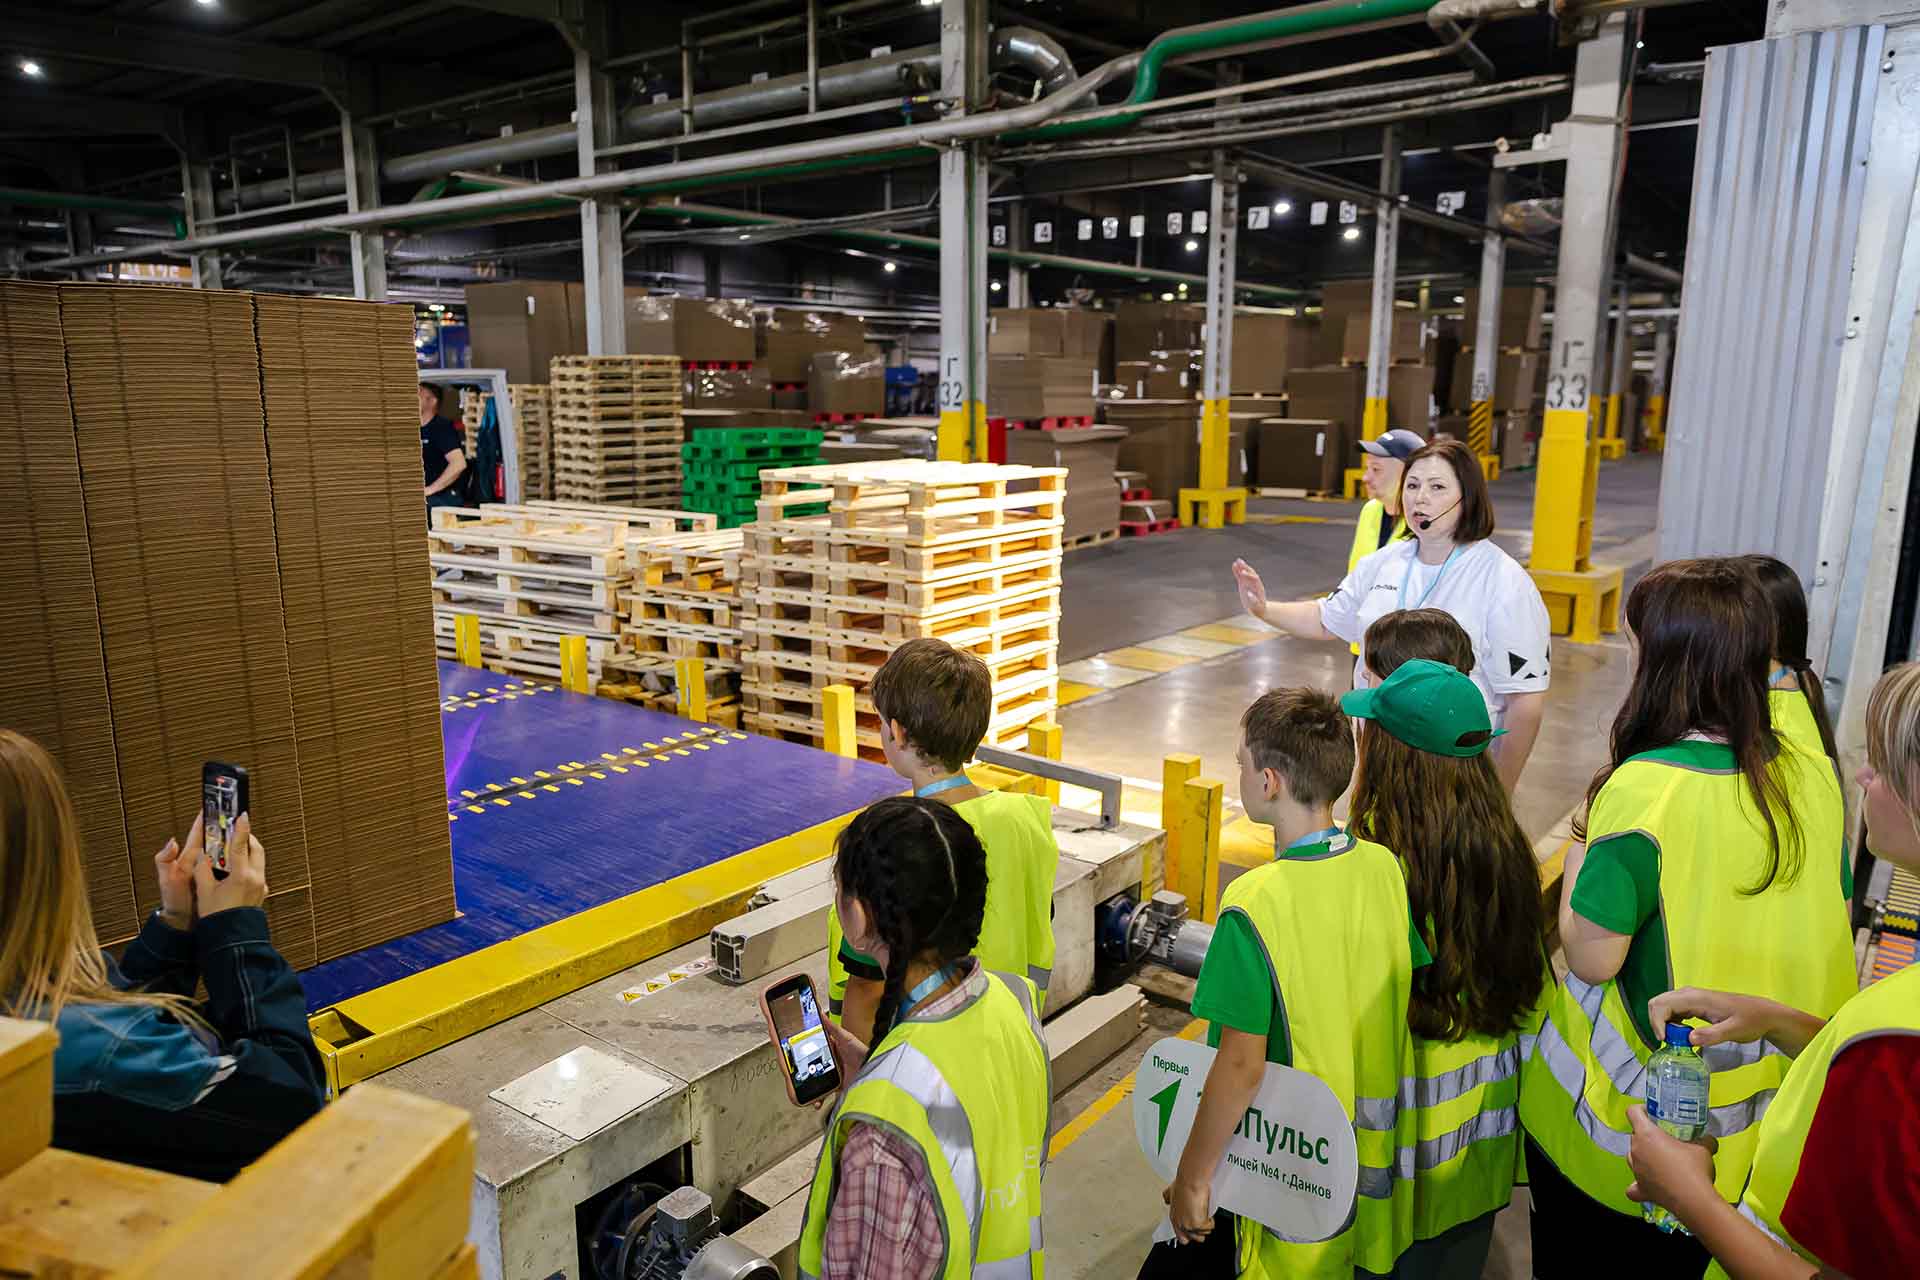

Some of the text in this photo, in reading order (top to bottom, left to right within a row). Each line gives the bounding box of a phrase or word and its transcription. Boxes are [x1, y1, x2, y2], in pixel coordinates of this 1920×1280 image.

[1250, 210, 1261, 228] 7
[1039, 224, 1049, 239] 4
[947, 358, 958, 377] Г
[942, 381, 962, 406] 32
[1550, 374, 1586, 409] 33
[1153, 1055, 1189, 1076] Первые
[1227, 1153, 1332, 1200] лицей №4 г.Данков
